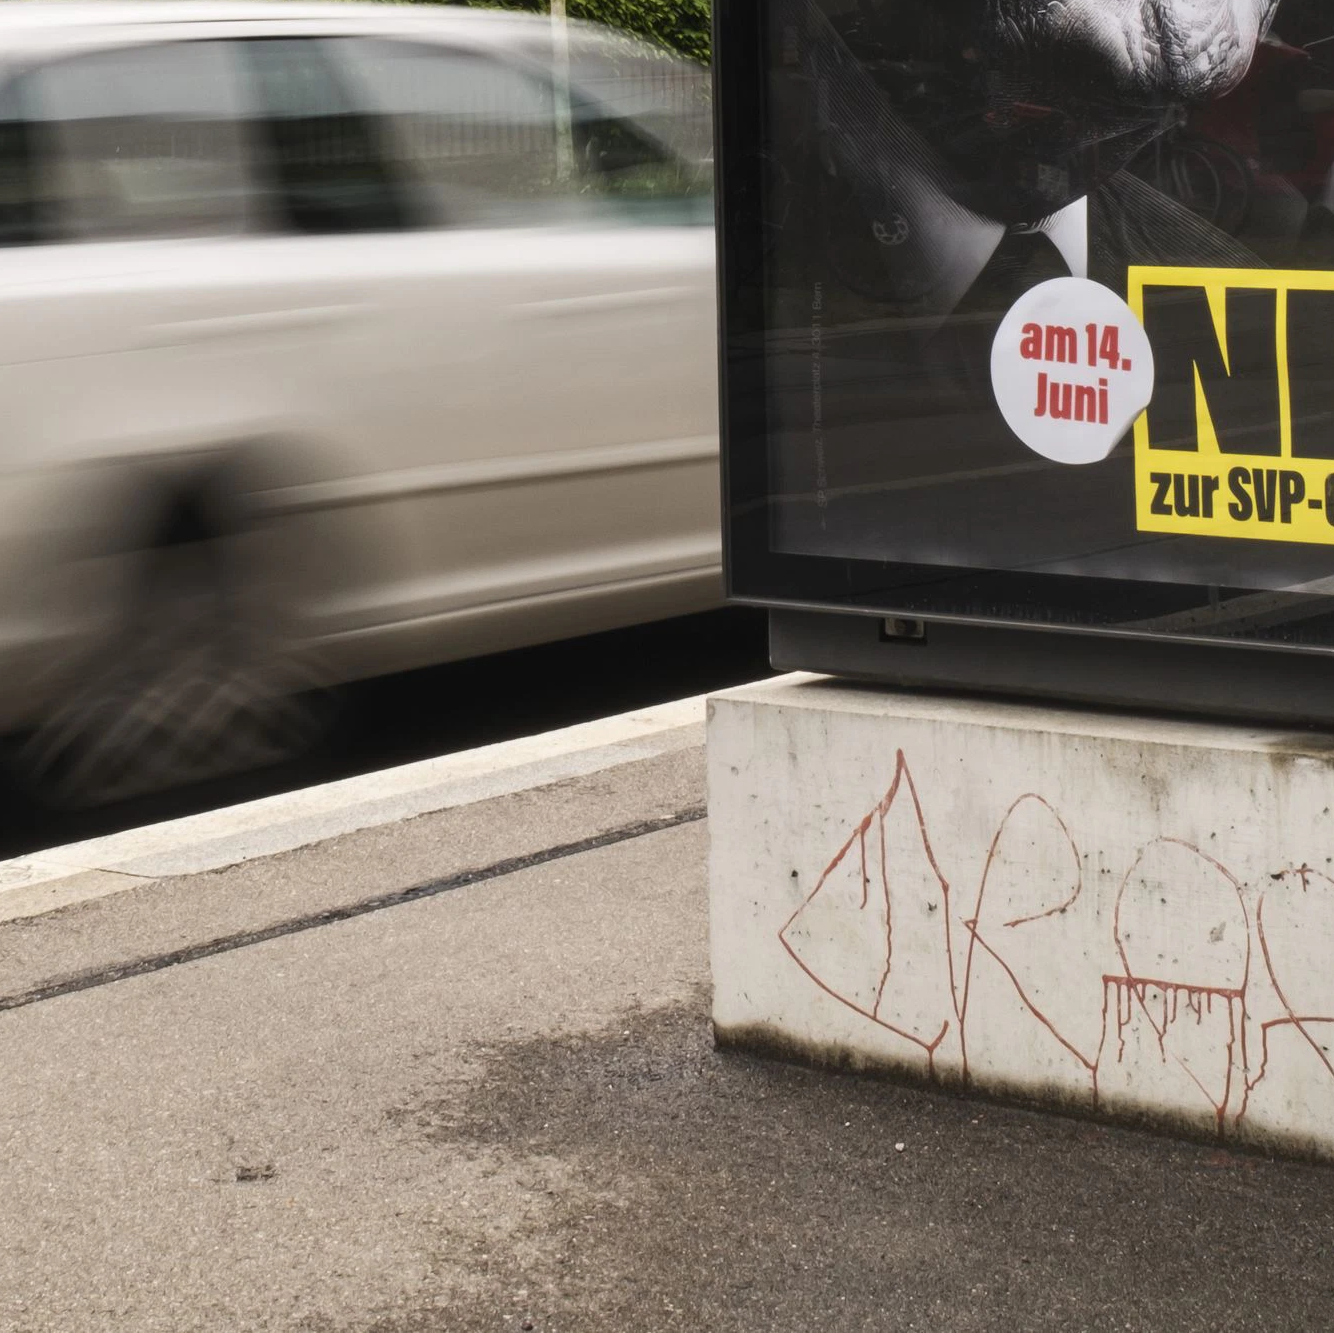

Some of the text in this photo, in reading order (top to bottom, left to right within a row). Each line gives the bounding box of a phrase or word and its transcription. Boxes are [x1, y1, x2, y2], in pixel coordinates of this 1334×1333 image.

[811, 282, 822, 309] Bern
[1021, 323, 1132, 372] am 14.
[1035, 372, 1109, 424] Juni
[1149, 471, 1219, 519] zur
